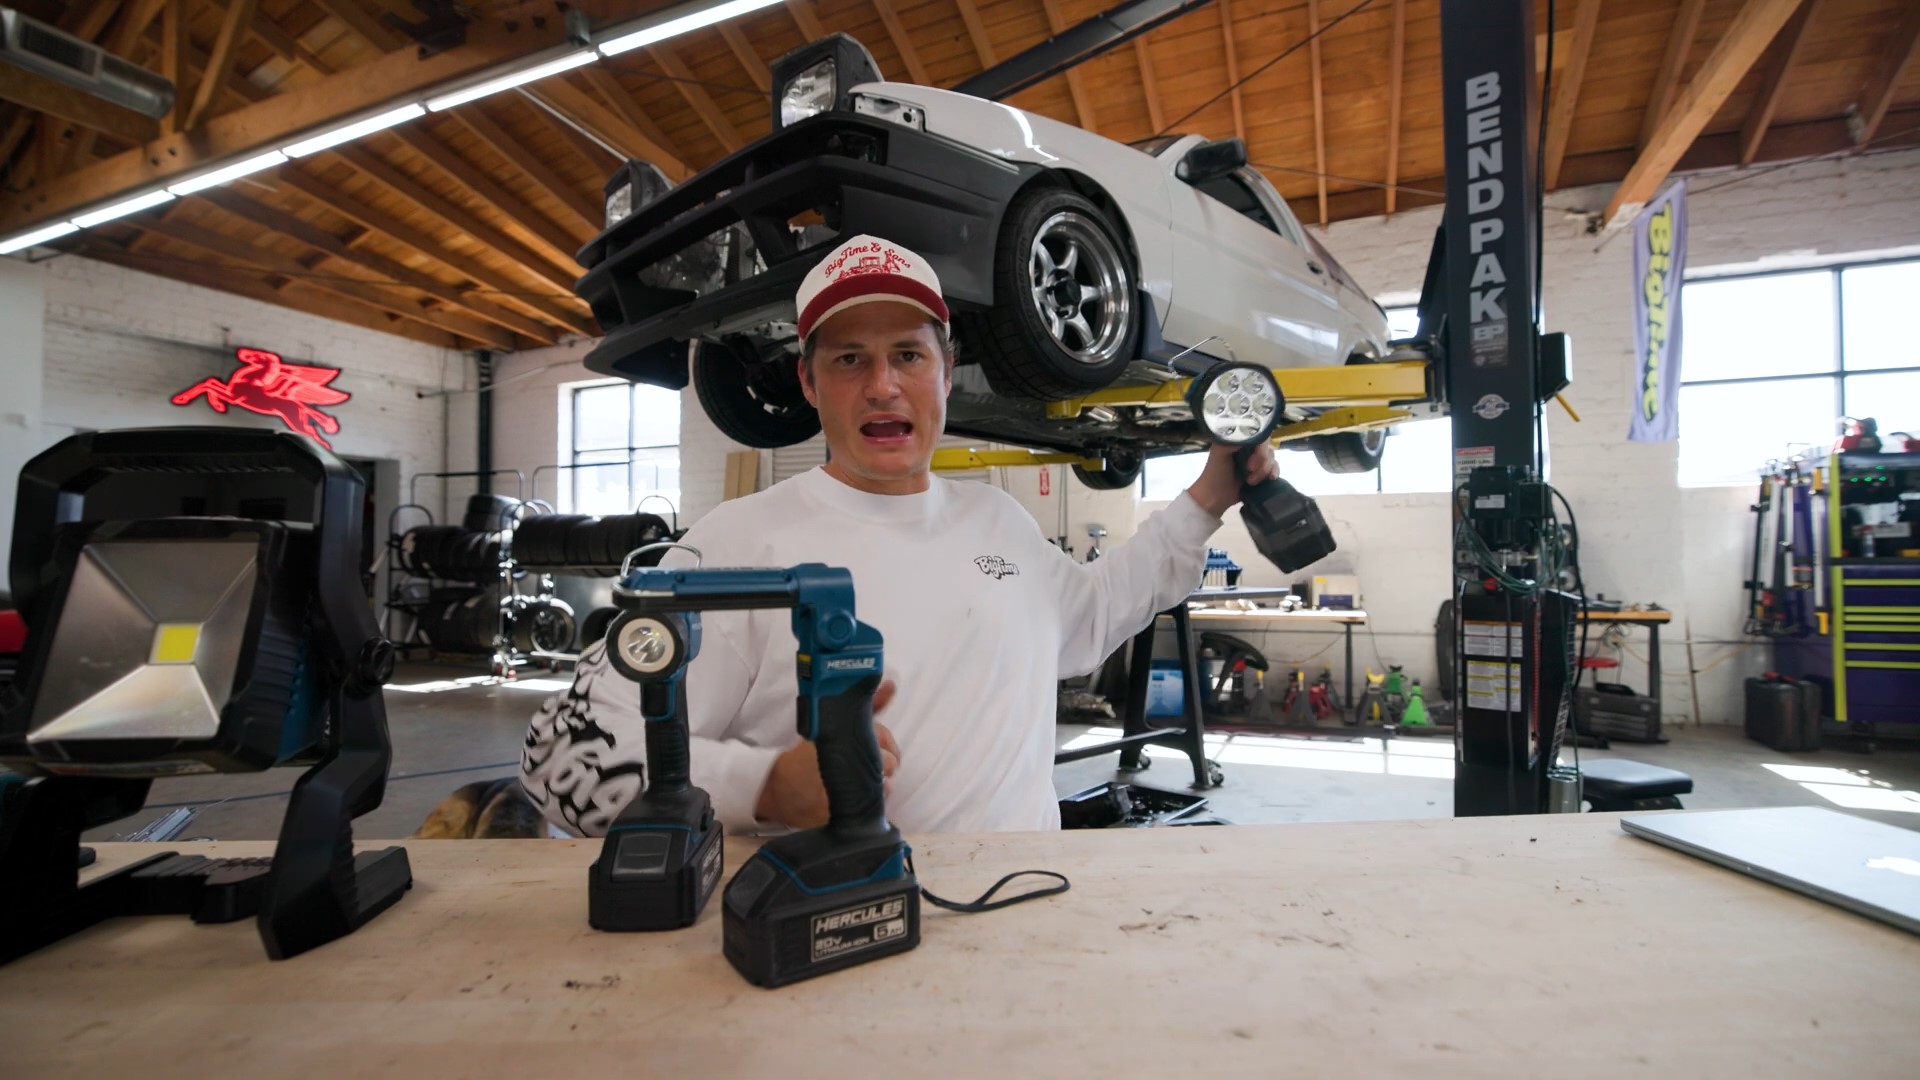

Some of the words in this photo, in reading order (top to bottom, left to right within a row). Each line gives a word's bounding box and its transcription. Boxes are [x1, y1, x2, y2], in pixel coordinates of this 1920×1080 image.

[1466, 71, 1507, 323] BENDPAK
[870, 242, 882, 252] &
[815, 899, 904, 934] HERCULES
[815, 935, 843, 951] 20V
